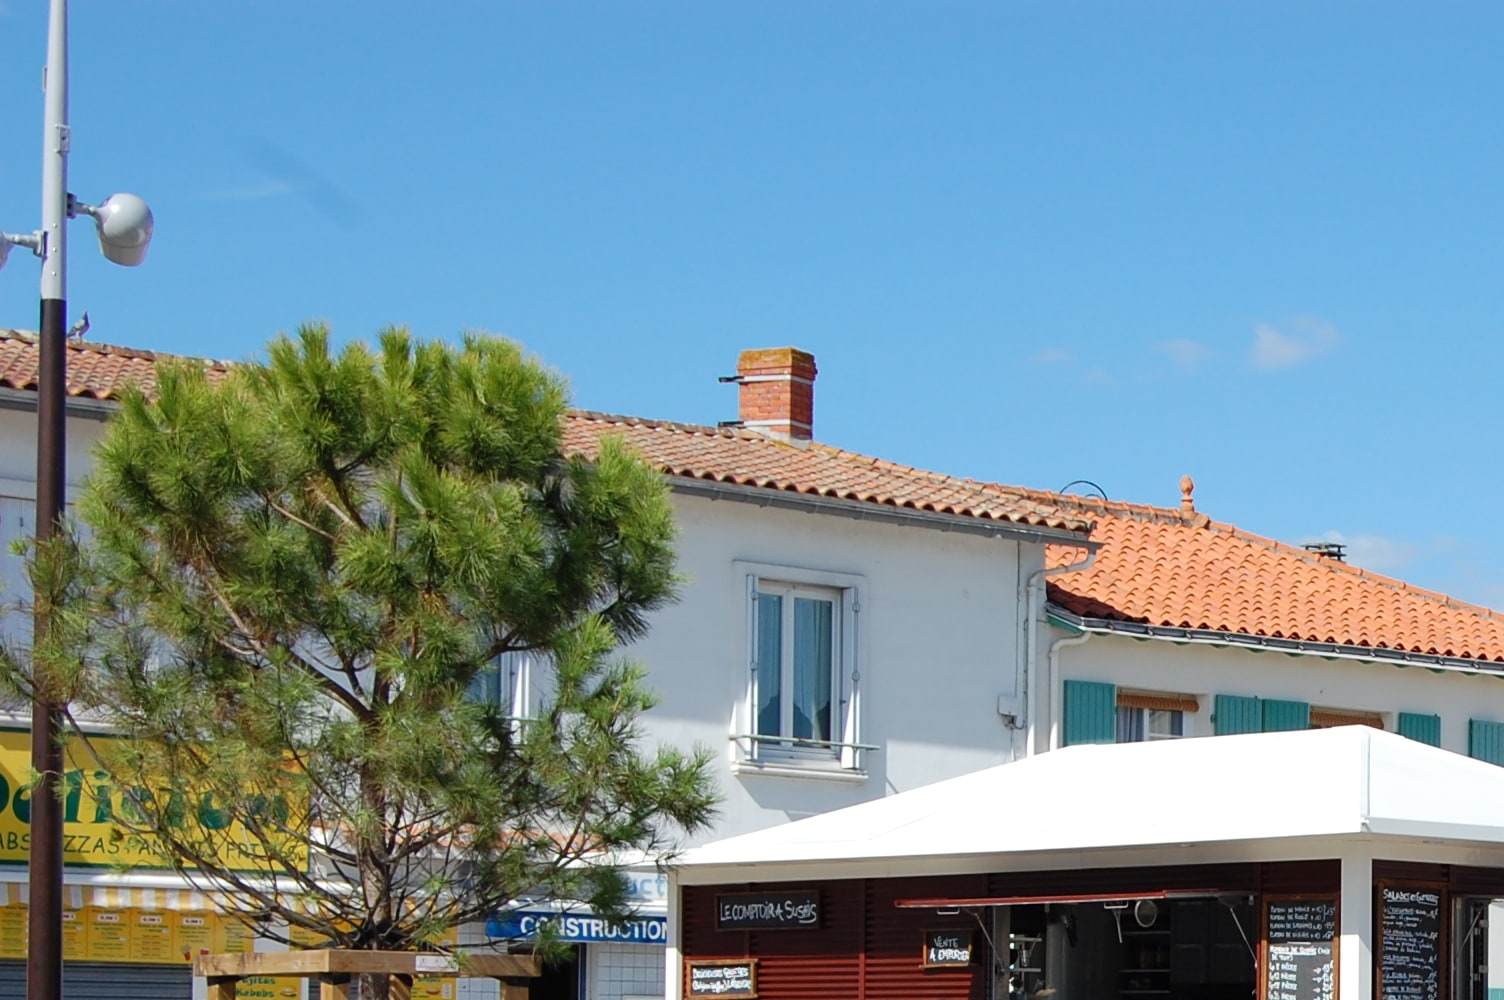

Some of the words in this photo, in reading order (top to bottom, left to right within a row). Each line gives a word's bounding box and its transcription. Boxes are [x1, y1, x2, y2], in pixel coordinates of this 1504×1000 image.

[64, 835, 120, 855] ZZAS
[720, 902, 731, 921] LE
[933, 936, 959, 949] VENTE
